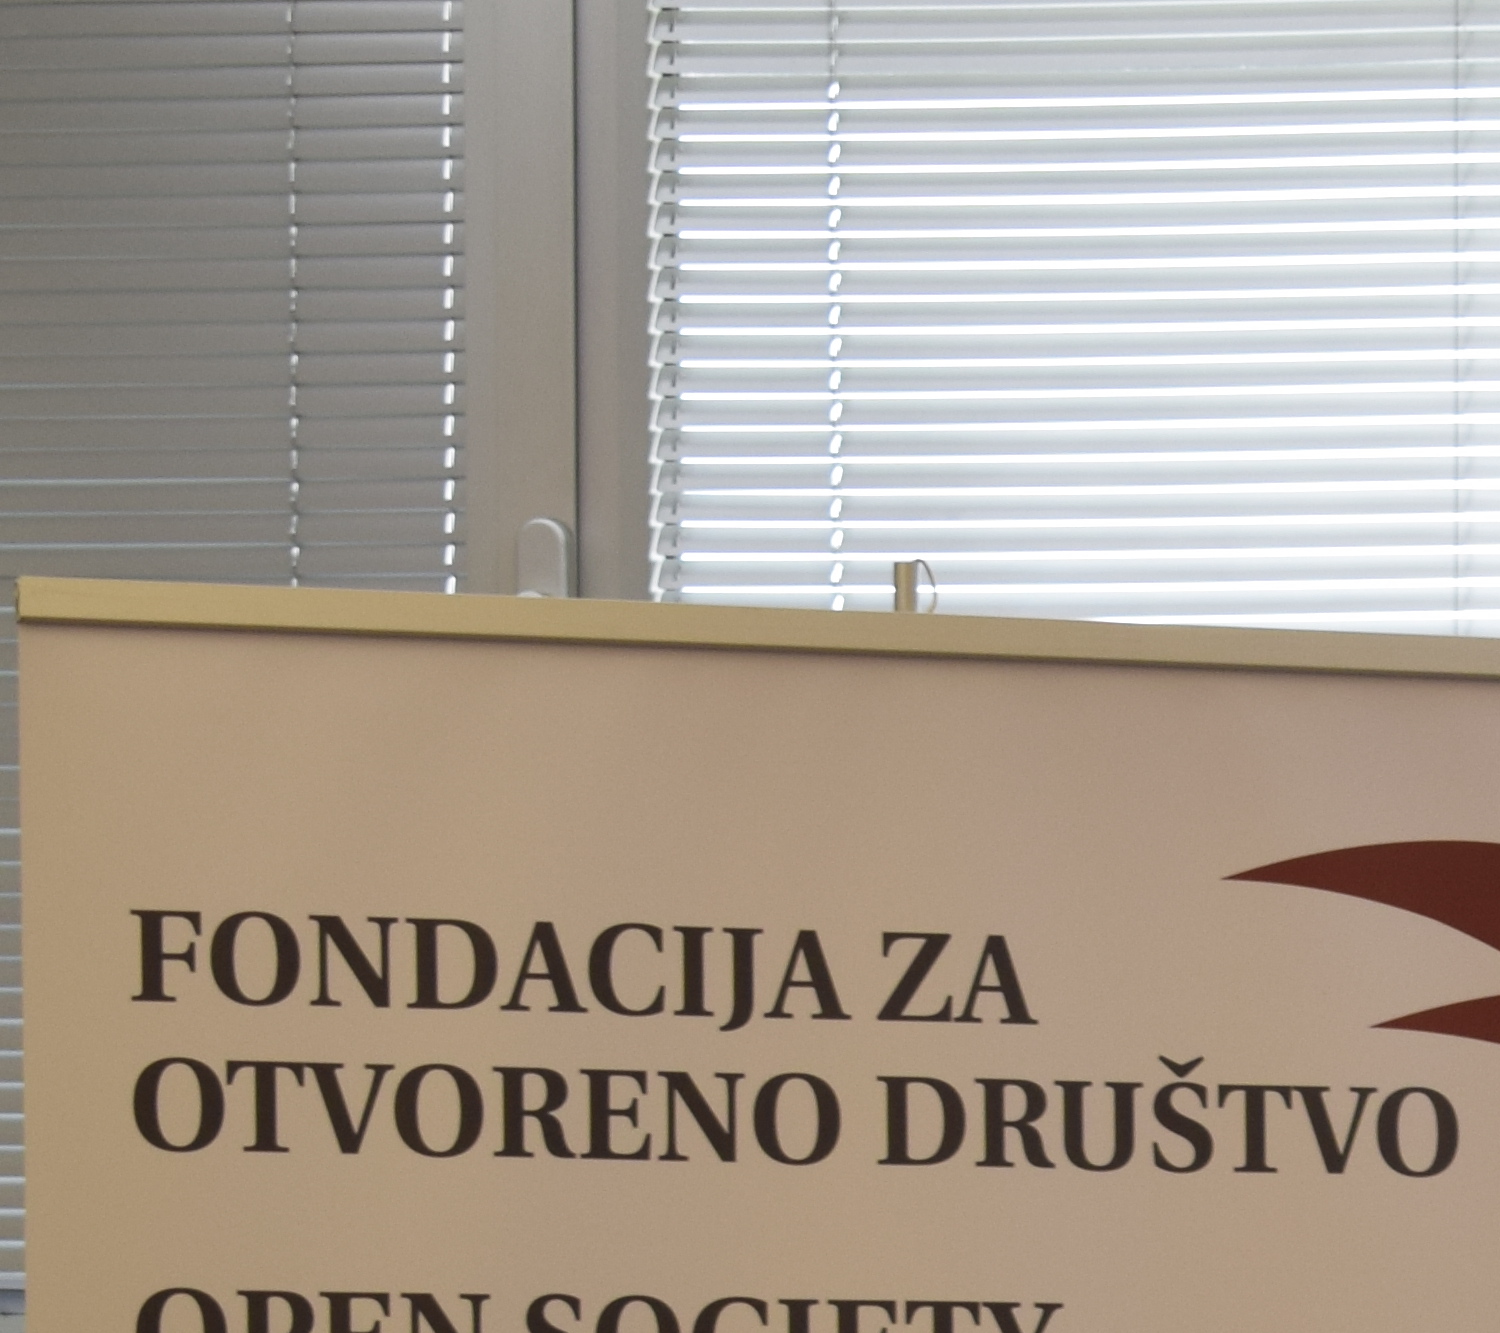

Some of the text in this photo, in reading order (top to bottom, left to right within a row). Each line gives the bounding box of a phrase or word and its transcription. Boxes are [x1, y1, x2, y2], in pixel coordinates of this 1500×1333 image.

[130, 908, 1039, 1031] FONDACIJA ZA
[130, 1054, 1461, 1180] OTVORENO DRUŠTVO
